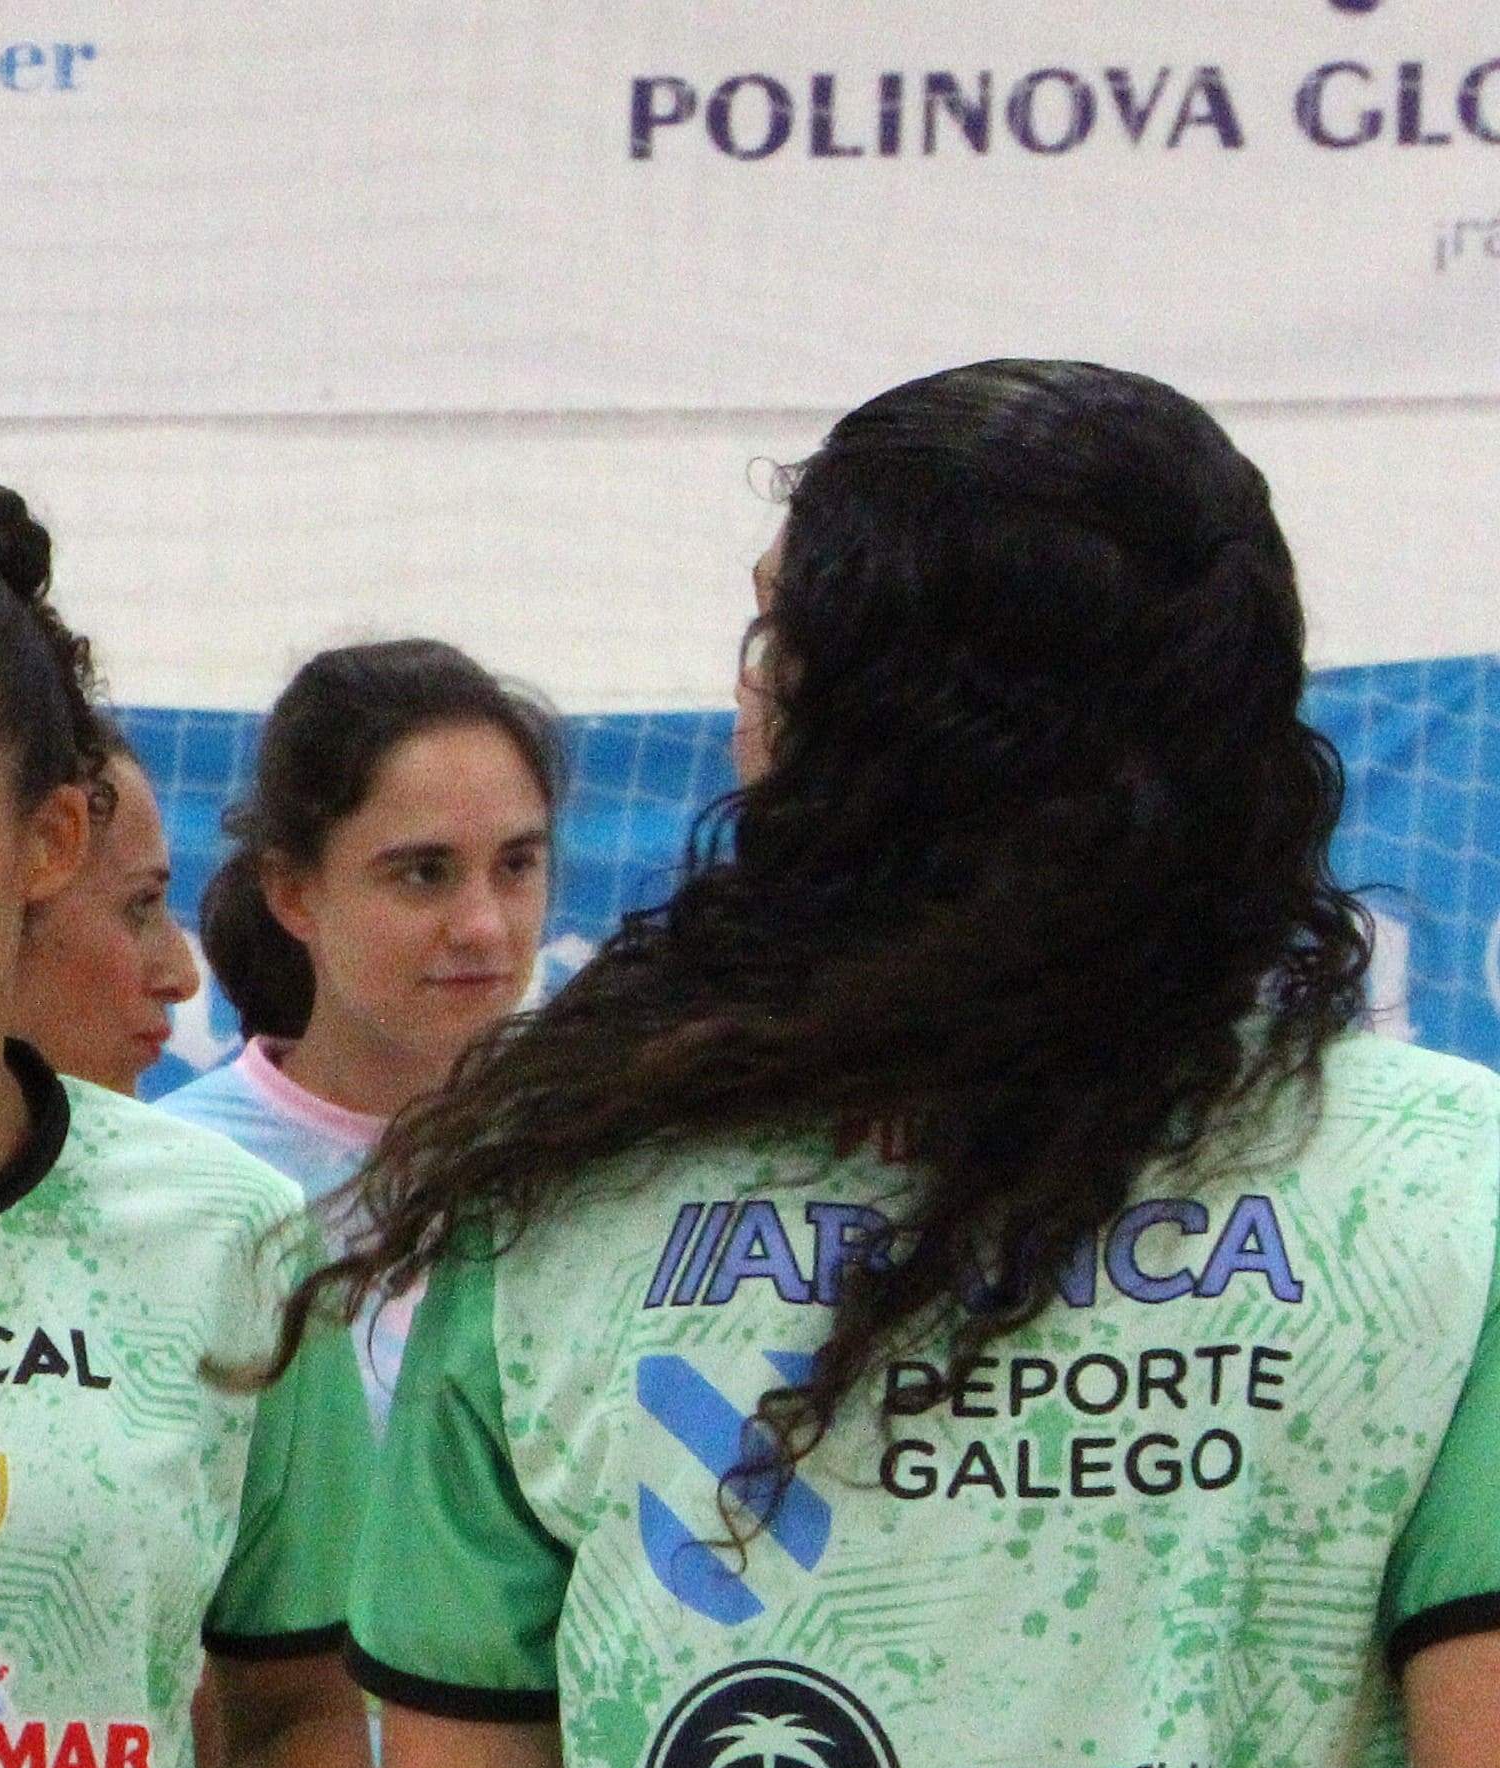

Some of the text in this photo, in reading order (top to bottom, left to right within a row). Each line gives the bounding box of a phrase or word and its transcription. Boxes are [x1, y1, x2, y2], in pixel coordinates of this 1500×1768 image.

[627, 65, 1245, 160] POLINOVA
[888, 1345, 1292, 1418] DEPORTE
[879, 1428, 1244, 1499] GALEGO
